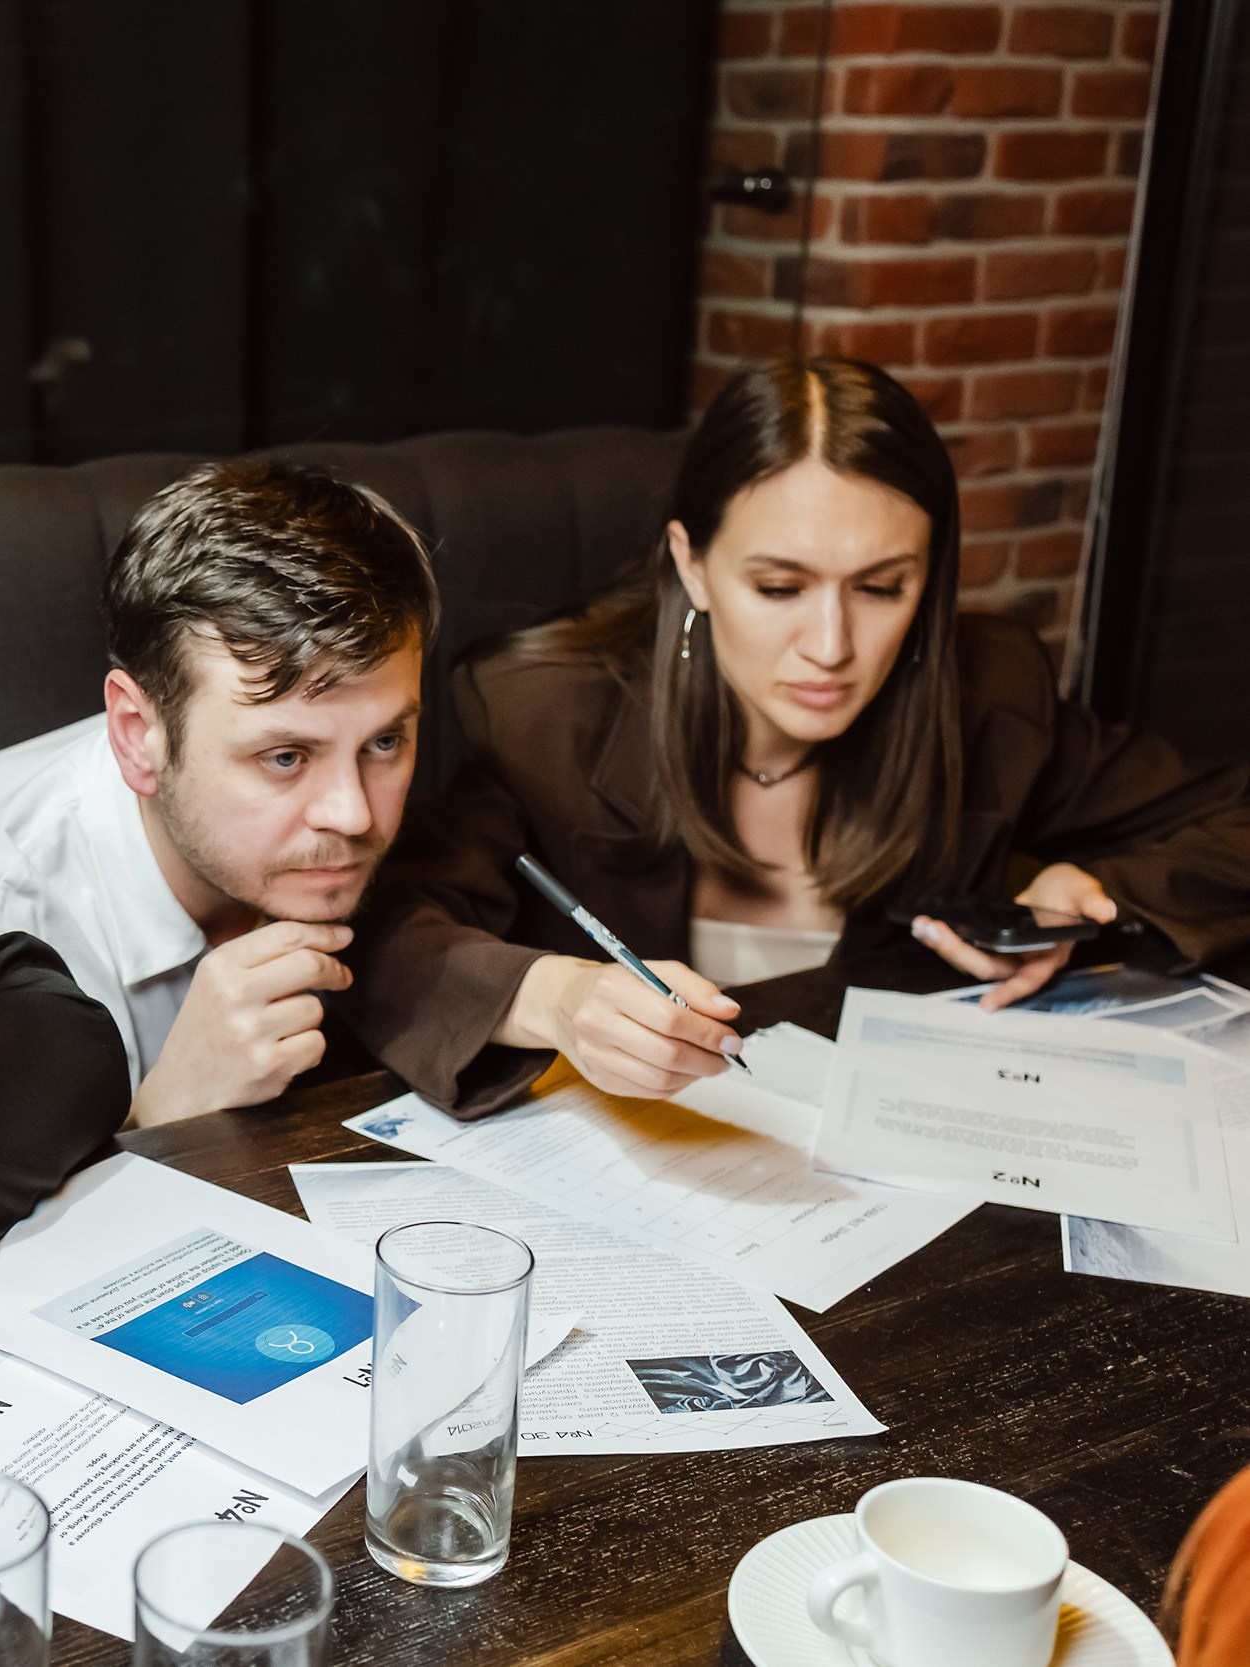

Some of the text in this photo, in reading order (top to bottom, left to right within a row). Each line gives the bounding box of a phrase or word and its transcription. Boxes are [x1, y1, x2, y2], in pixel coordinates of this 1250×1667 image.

[145, 1422, 160, 1433] one
[133, 1432, 148, 1443] you
[140, 1436, 162, 1453] about
[122, 1442, 137, 1452] are
[154, 1440, 176, 1457] would
[179, 1440, 194, 1450] the
[84, 1451, 109, 1469] drops.
[99, 1451, 126, 1471] looking
[127, 1452, 144, 1464] half
[163, 1449, 183, 1464] east,
[90, 1469, 104, 1479] for
[108, 1467, 126, 1480] mile
[123, 1463, 149, 1483] perfect
[151, 1463, 167, 1474] you
[114, 1481, 127, 1490] for
[137, 1473, 156, 1487] have
[68, 1477, 94, 1498] passed
[90, 1484, 105, 1495] the
[69, 1494, 94, 1512] north,
[85, 1490, 117, 1514] Jackson,
[109, 1490, 135, 1510] chance
[56, 1511, 73, 1523] you
[65, 1513, 89, 1531] Kong,
[73, 1516, 104, 1541] discover
